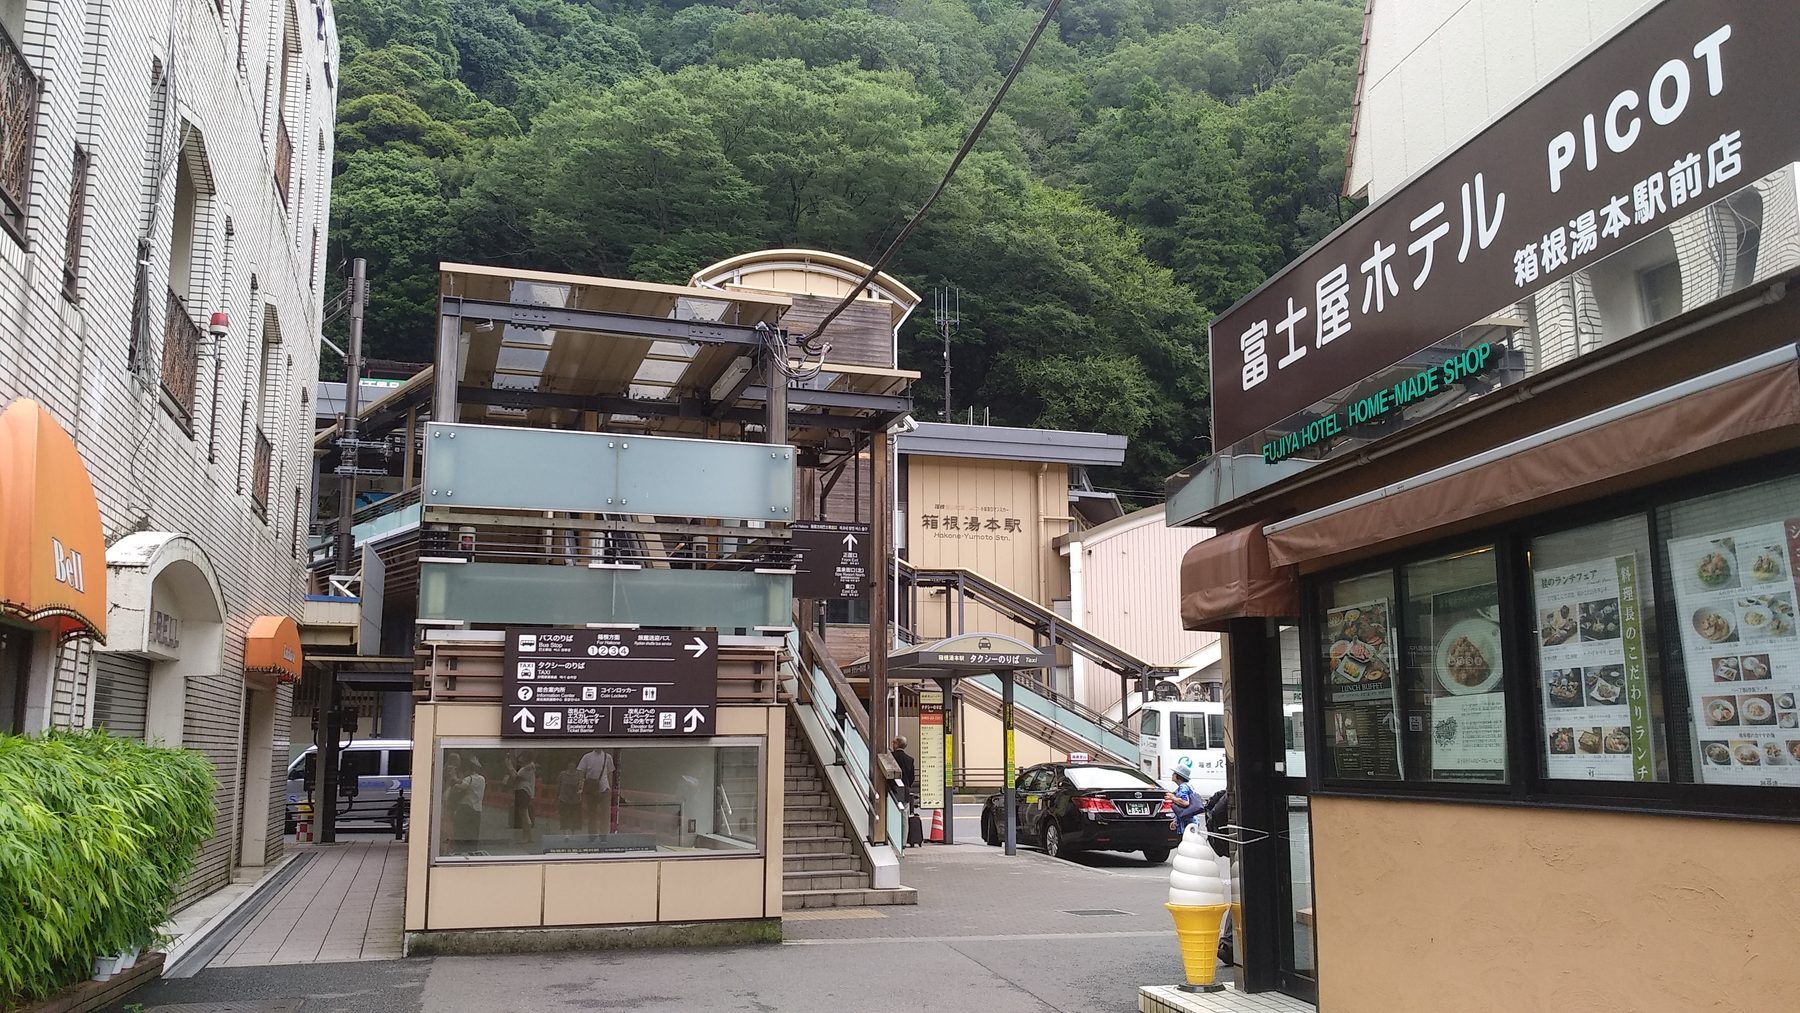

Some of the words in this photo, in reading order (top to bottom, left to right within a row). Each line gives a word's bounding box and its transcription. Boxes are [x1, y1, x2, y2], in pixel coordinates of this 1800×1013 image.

[1548, 24, 1731, 192] PICOT
[1513, 129, 1742, 287] 箱根湯本駅前店
[1240, 172, 1505, 391] 富士屋ホテル
[1263, 432, 1299, 464] FUJIYA
[1301, 413, 1341, 447] HOTEL
[1348, 367, 1439, 426] HOME-MADE
[1443, 343, 1490, 384] SHOP
[51, 536, 85, 594] Bell
[921, 514, 1022, 533] 箱根湯本駅
[970, 654, 1020, 664] タクシーのりば
[1620, 566, 1648, 780] 料理長のこだわりランチ
